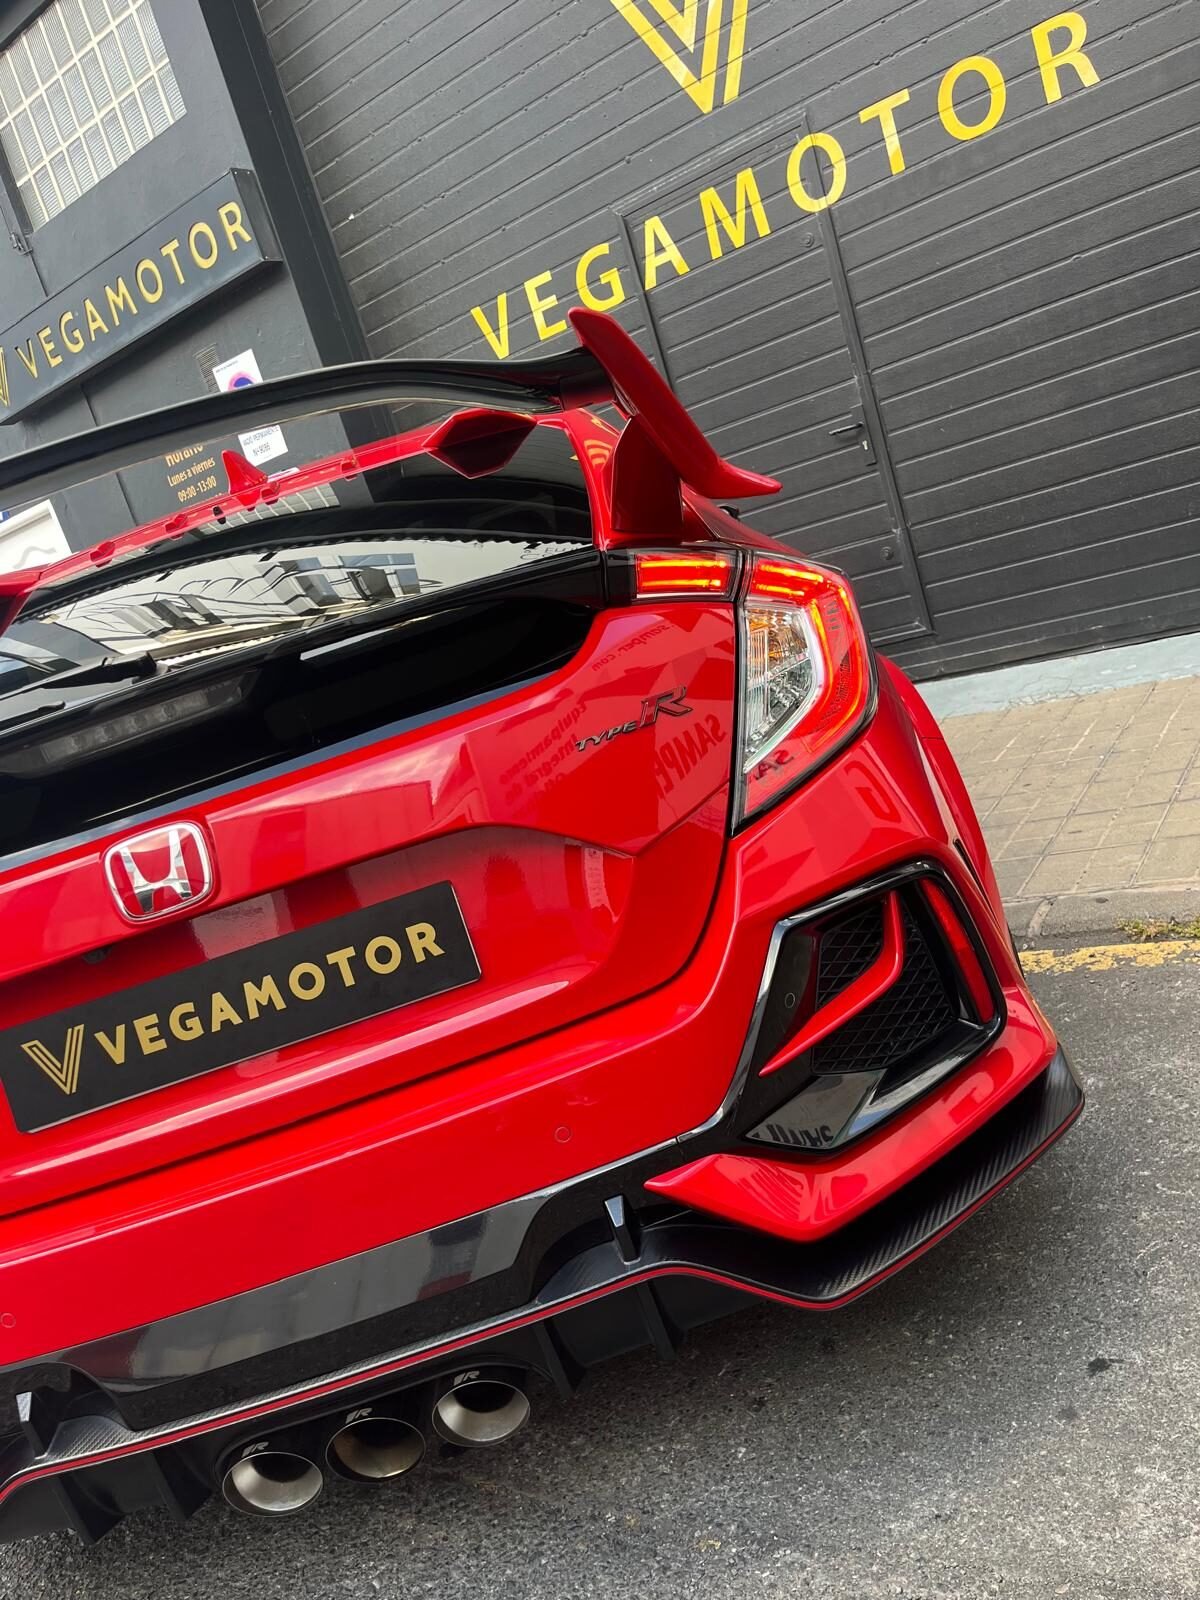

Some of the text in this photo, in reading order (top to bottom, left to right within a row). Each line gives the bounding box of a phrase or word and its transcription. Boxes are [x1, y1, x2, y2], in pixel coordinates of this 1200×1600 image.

[471, 11, 1100, 359] VEGAMOTOR
[16, 202, 252, 379] VEGAMOTOR
[575, 684, 694, 752] TYPE R
[95, 922, 446, 1065] VEGAMOTOR
